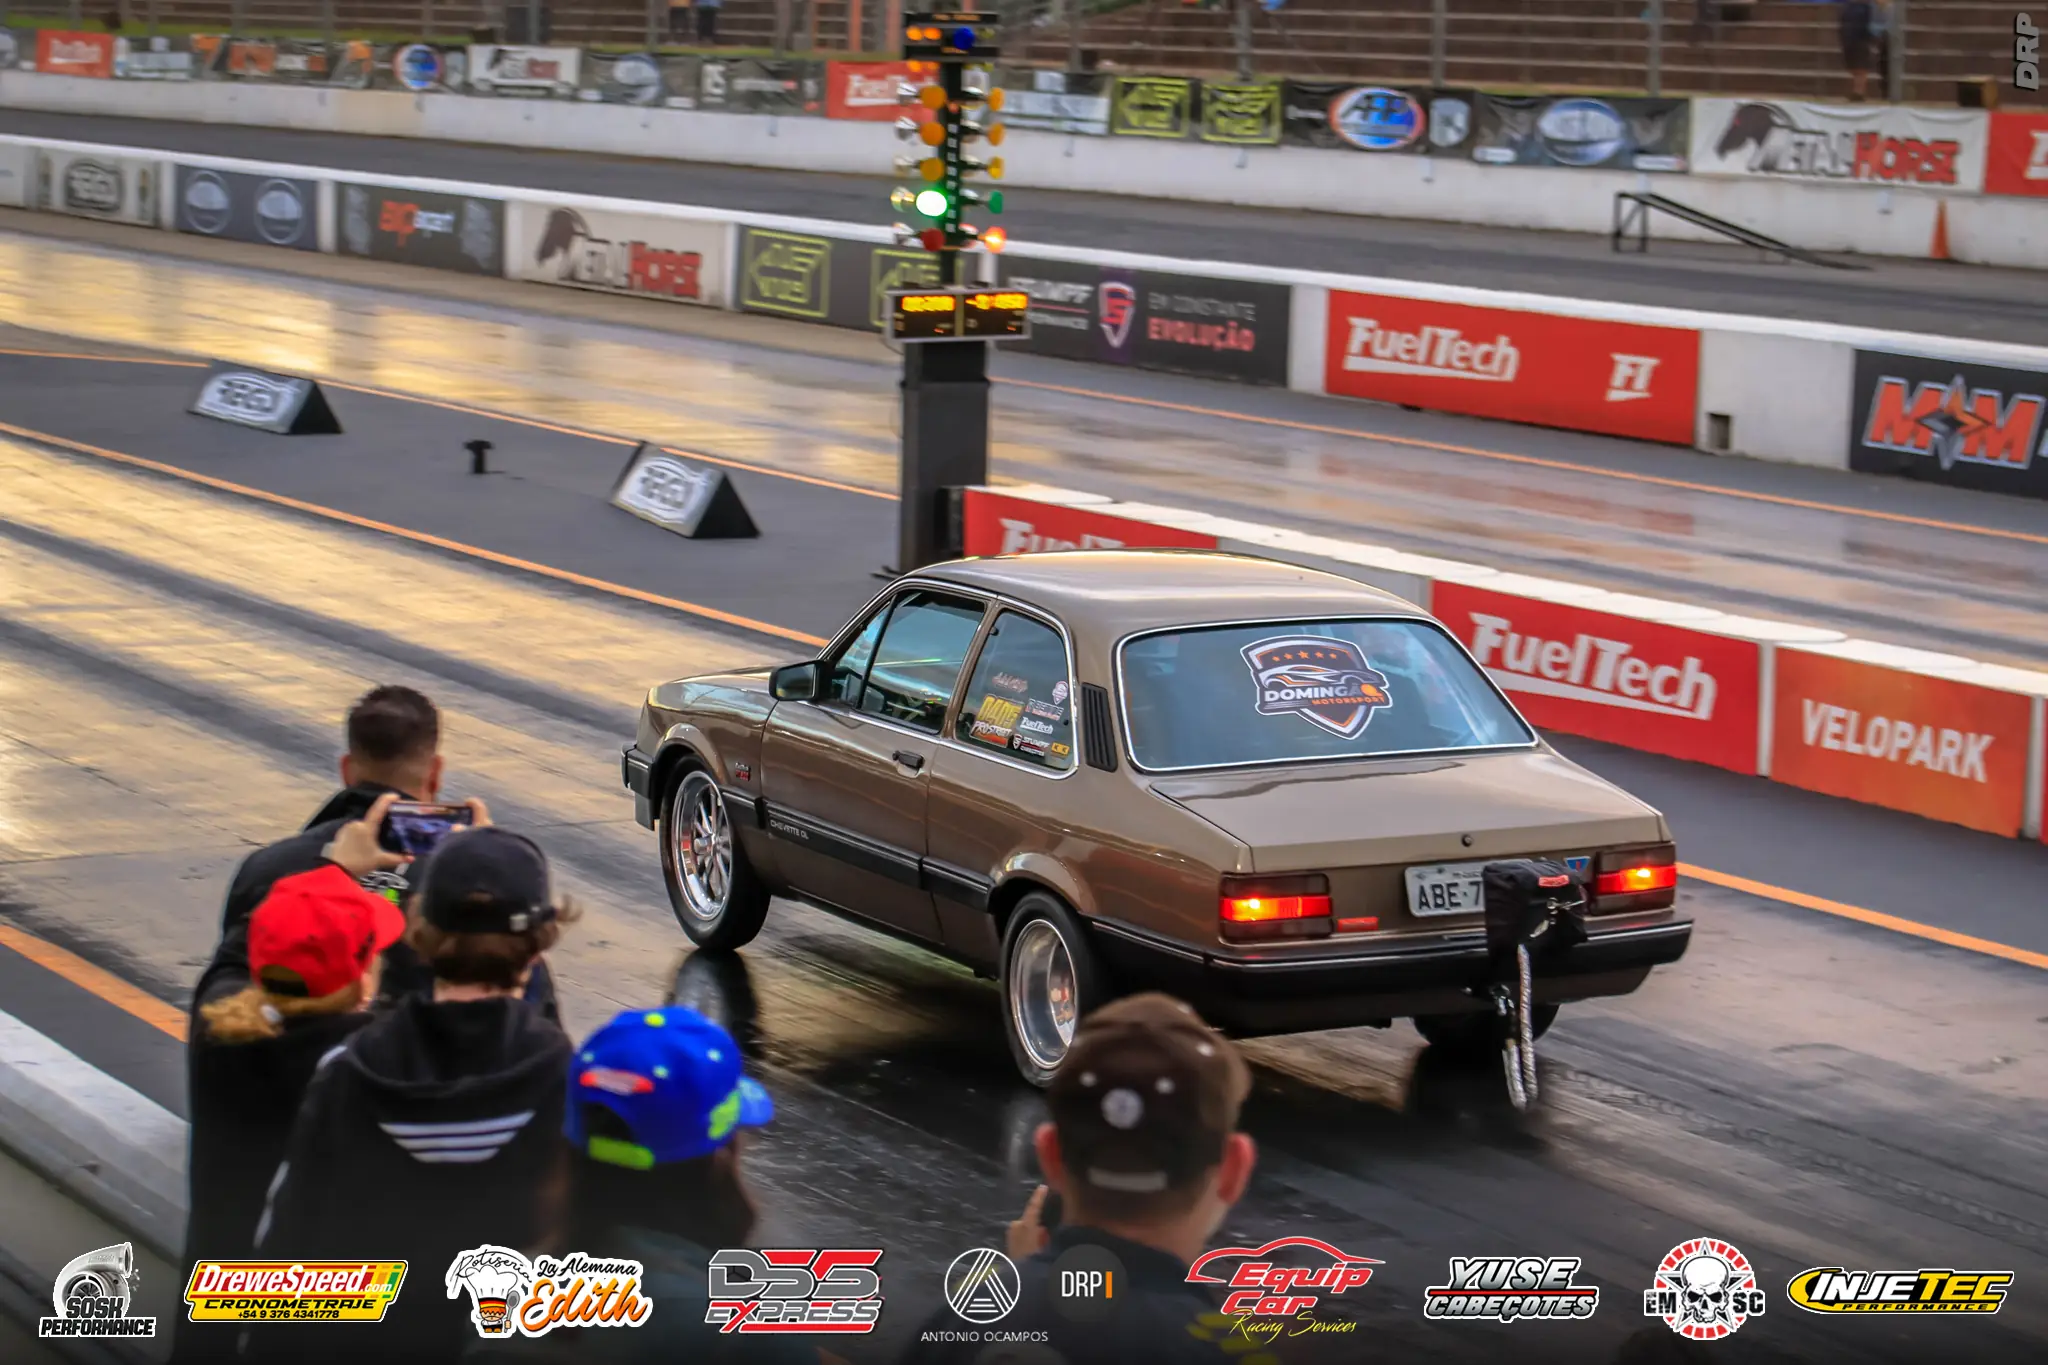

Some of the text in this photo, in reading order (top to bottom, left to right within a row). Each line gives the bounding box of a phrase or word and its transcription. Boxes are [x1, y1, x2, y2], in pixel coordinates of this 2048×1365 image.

[1346, 315, 1521, 382] FuelTech
[1468, 611, 1718, 721] FuelTech
[1020, 716, 1054, 735] FuelTech
[1802, 698, 1996, 784] VELOPARK
[770, 820, 800, 836] CHEVETTE
